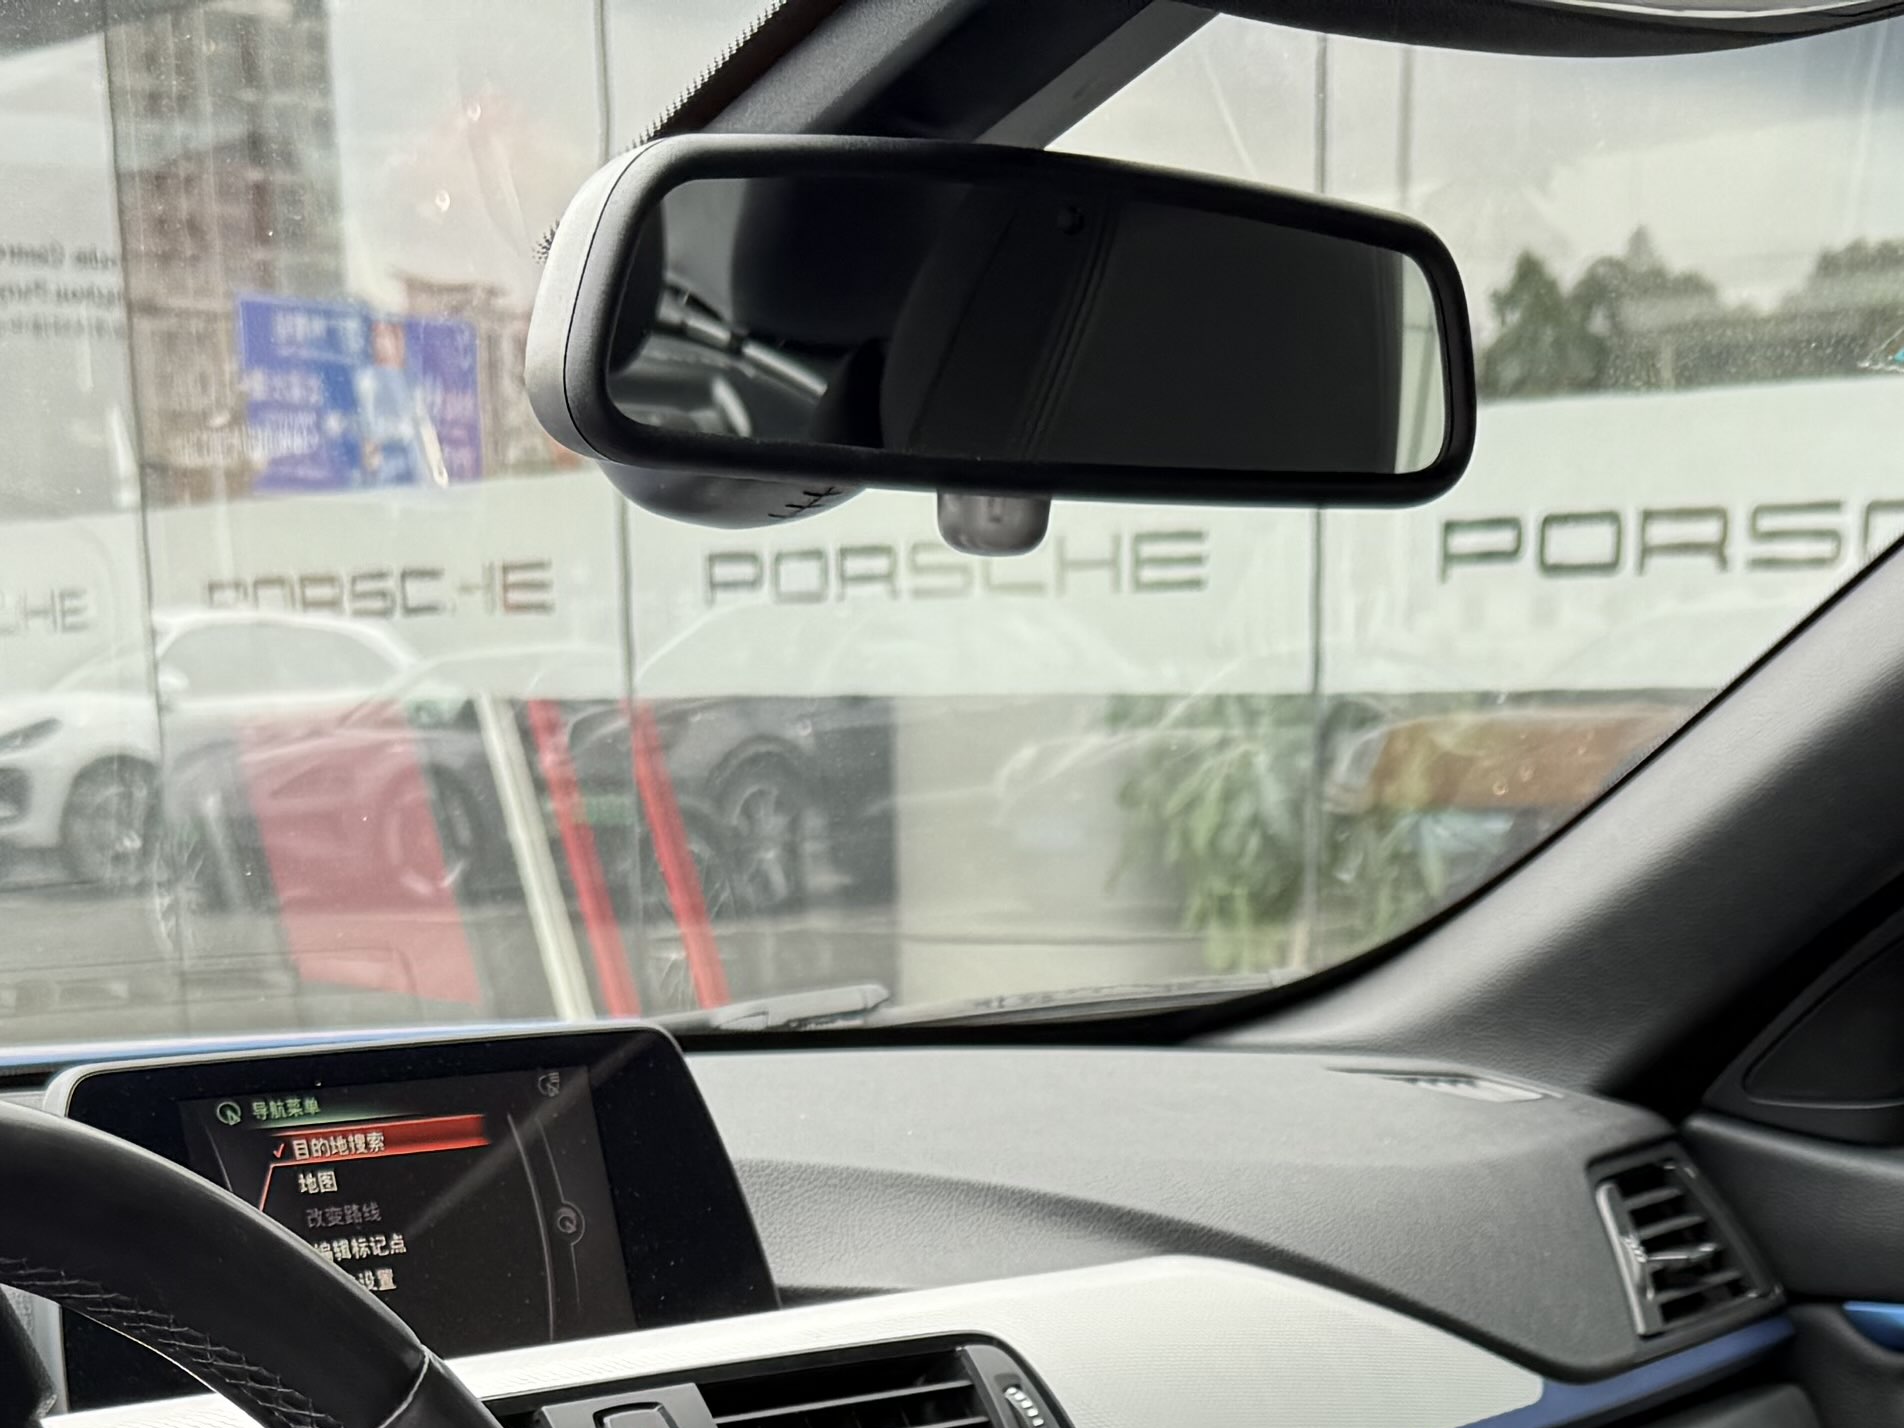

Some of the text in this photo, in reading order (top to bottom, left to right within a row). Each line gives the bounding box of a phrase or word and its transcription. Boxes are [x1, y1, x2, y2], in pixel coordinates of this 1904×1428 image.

[704, 530, 1209, 606] PORSCHE
[252, 1097, 320, 1121] 导航菜单
[292, 1132, 385, 1160] 目的地搜索
[298, 1170, 338, 1194] 地图
[306, 1201, 382, 1228] 改变路线
